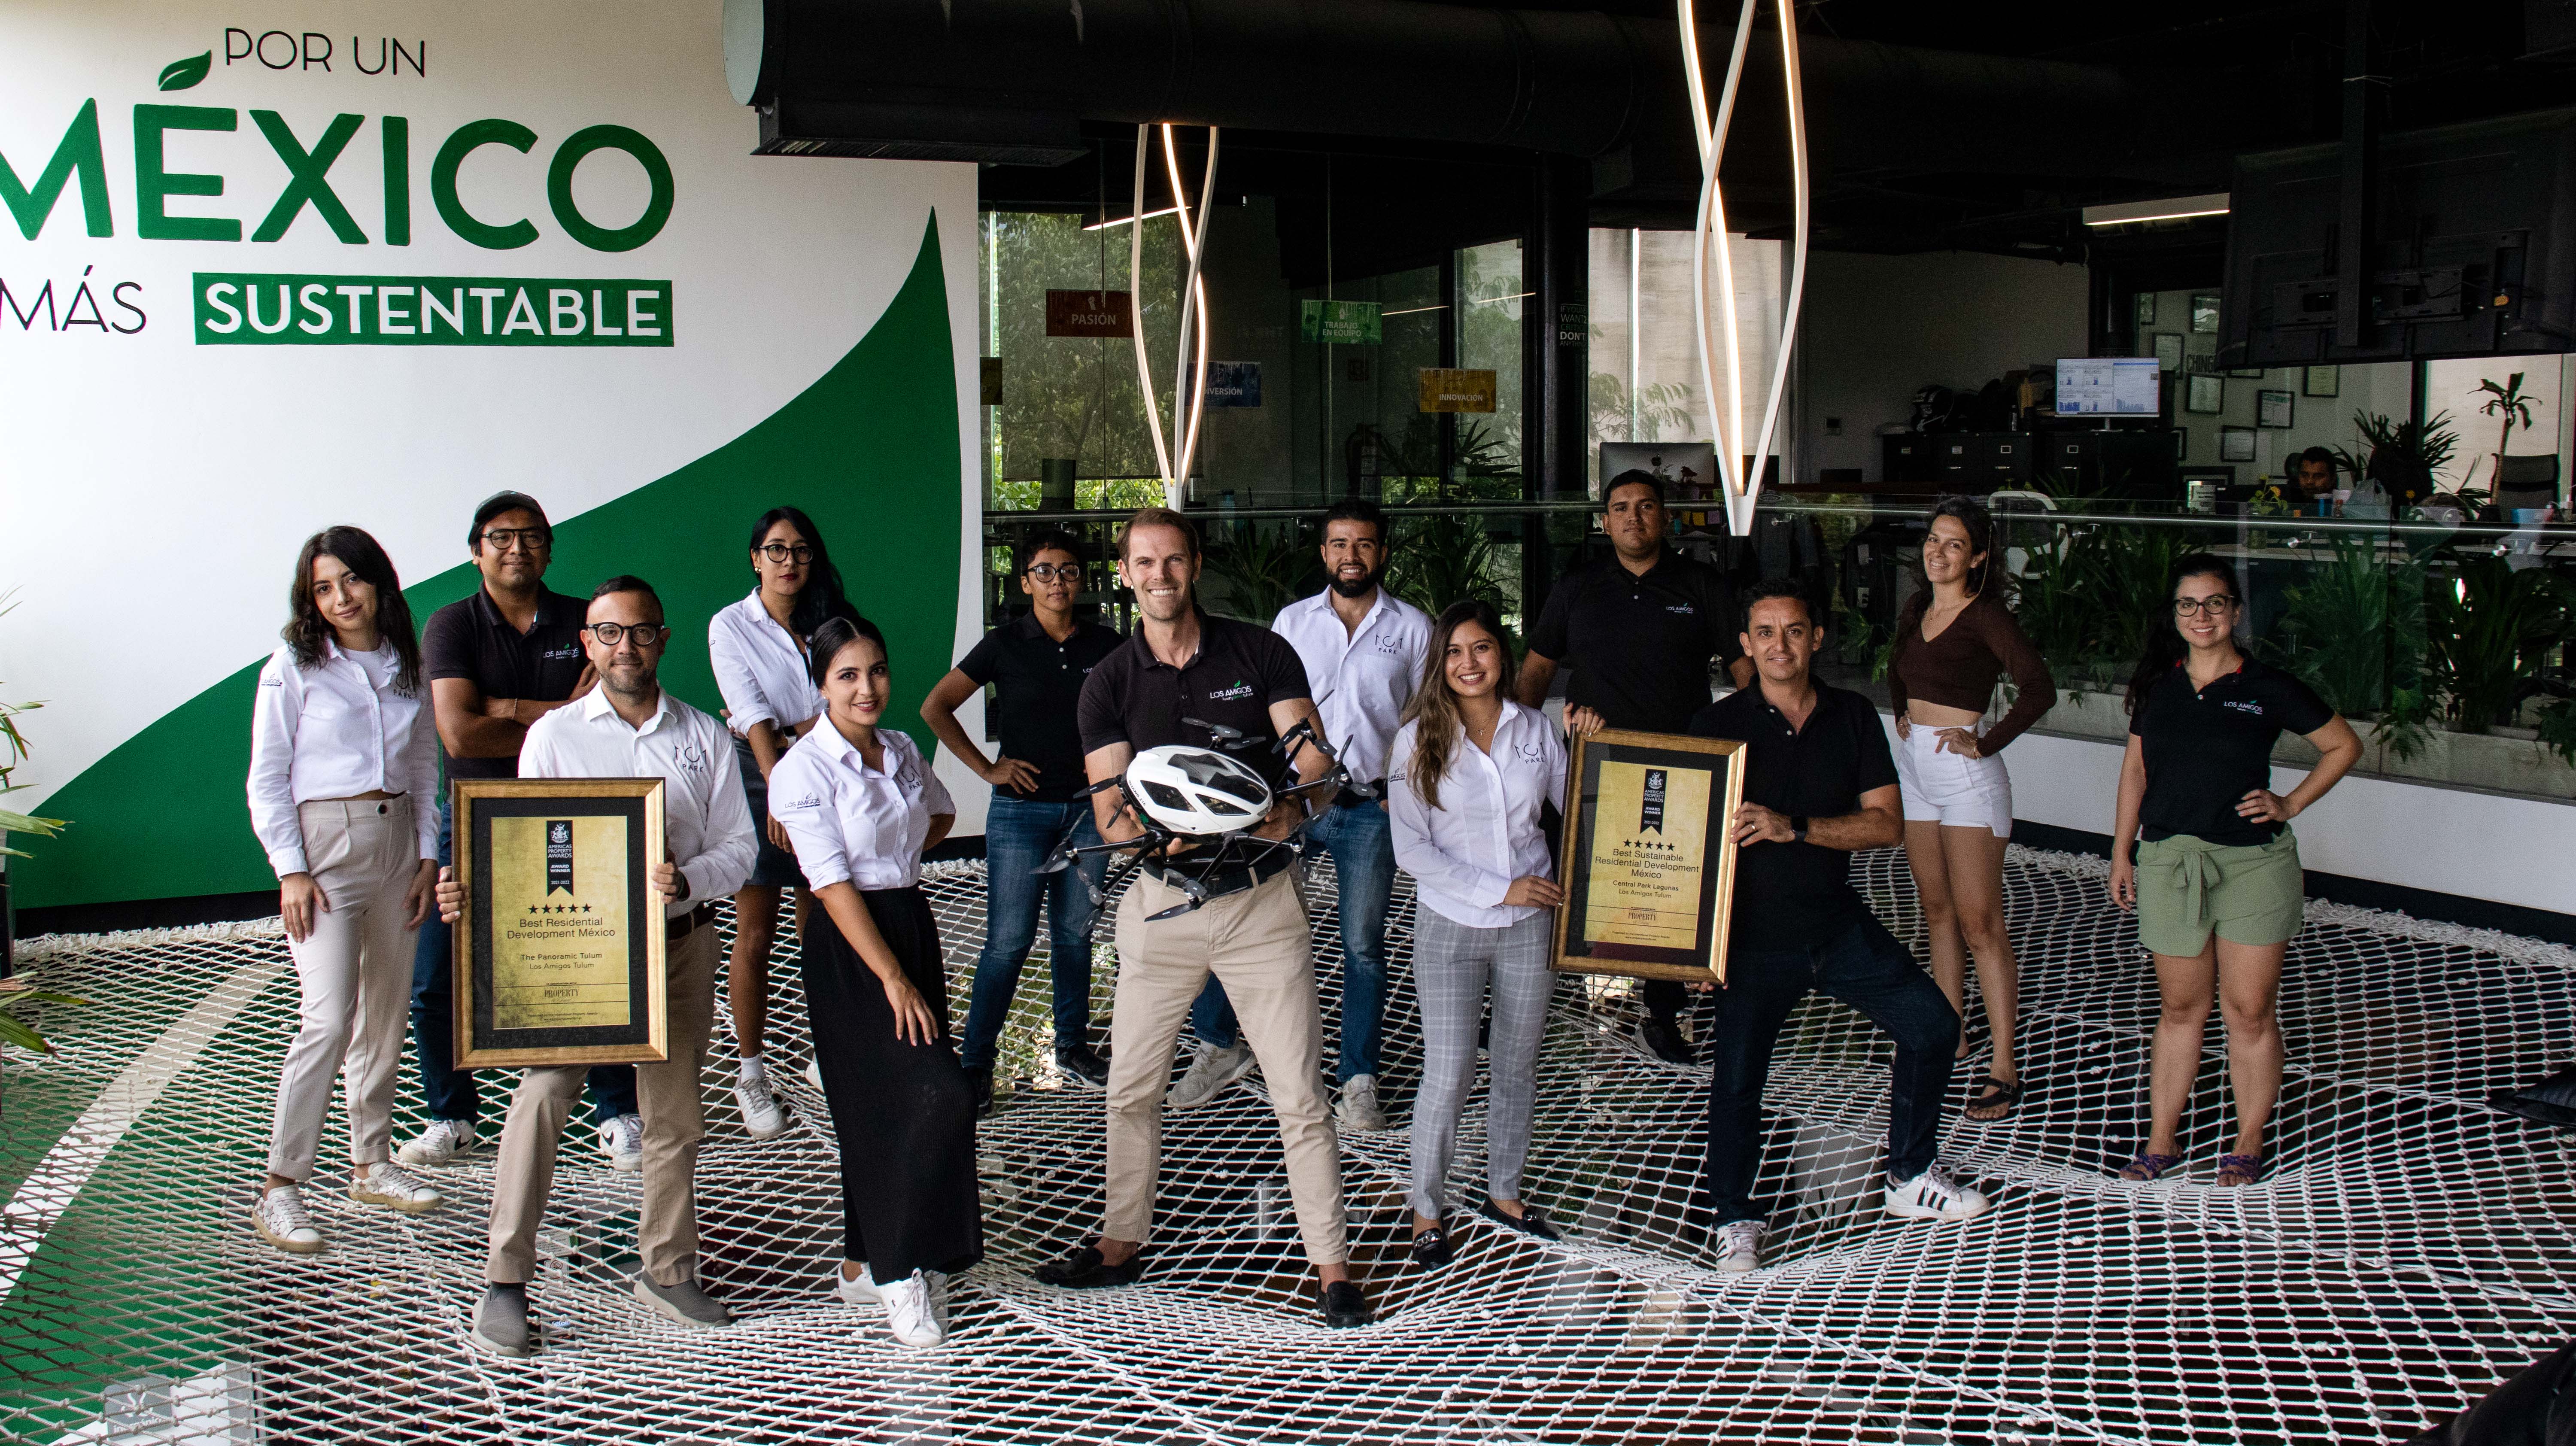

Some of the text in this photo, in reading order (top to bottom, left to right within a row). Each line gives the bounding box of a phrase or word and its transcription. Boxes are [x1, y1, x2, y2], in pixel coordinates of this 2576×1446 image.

[226, 28, 426, 77] POR UN
[0, 49, 674, 252] MÉXICO
[0, 265, 662, 337] MÁS SUSTENTABLE
[1071, 313, 1116, 325] PASIÓN
[1324, 321, 1358, 329] TRABAJO
[1559, 331, 1586, 341] DON'T
[2187, 354, 2216, 373] CHING
[1439, 393, 1483, 401] INNOVACIÓN
[556, 647, 580, 656] AMIGOS
[393, 689, 413, 700] PARK
[1209, 690, 1224, 699] LOS
[1225, 685, 1252, 697] AMIGOS
[2238, 702, 2263, 712] AMIGOS
[682, 764, 704, 772] PARK
[797, 798, 820, 806] AMIGOS
[1613, 849, 1683, 862] Best Sustainable
[1595, 856, 1699, 872] Residential Development
[1631, 869, 1662, 878] México
[1628, 912, 1656, 921] PROPERTY
[519, 917, 603, 927] Best Residential
[507, 928, 615, 940] Development México
[544, 989, 579, 997] PROPERTY
